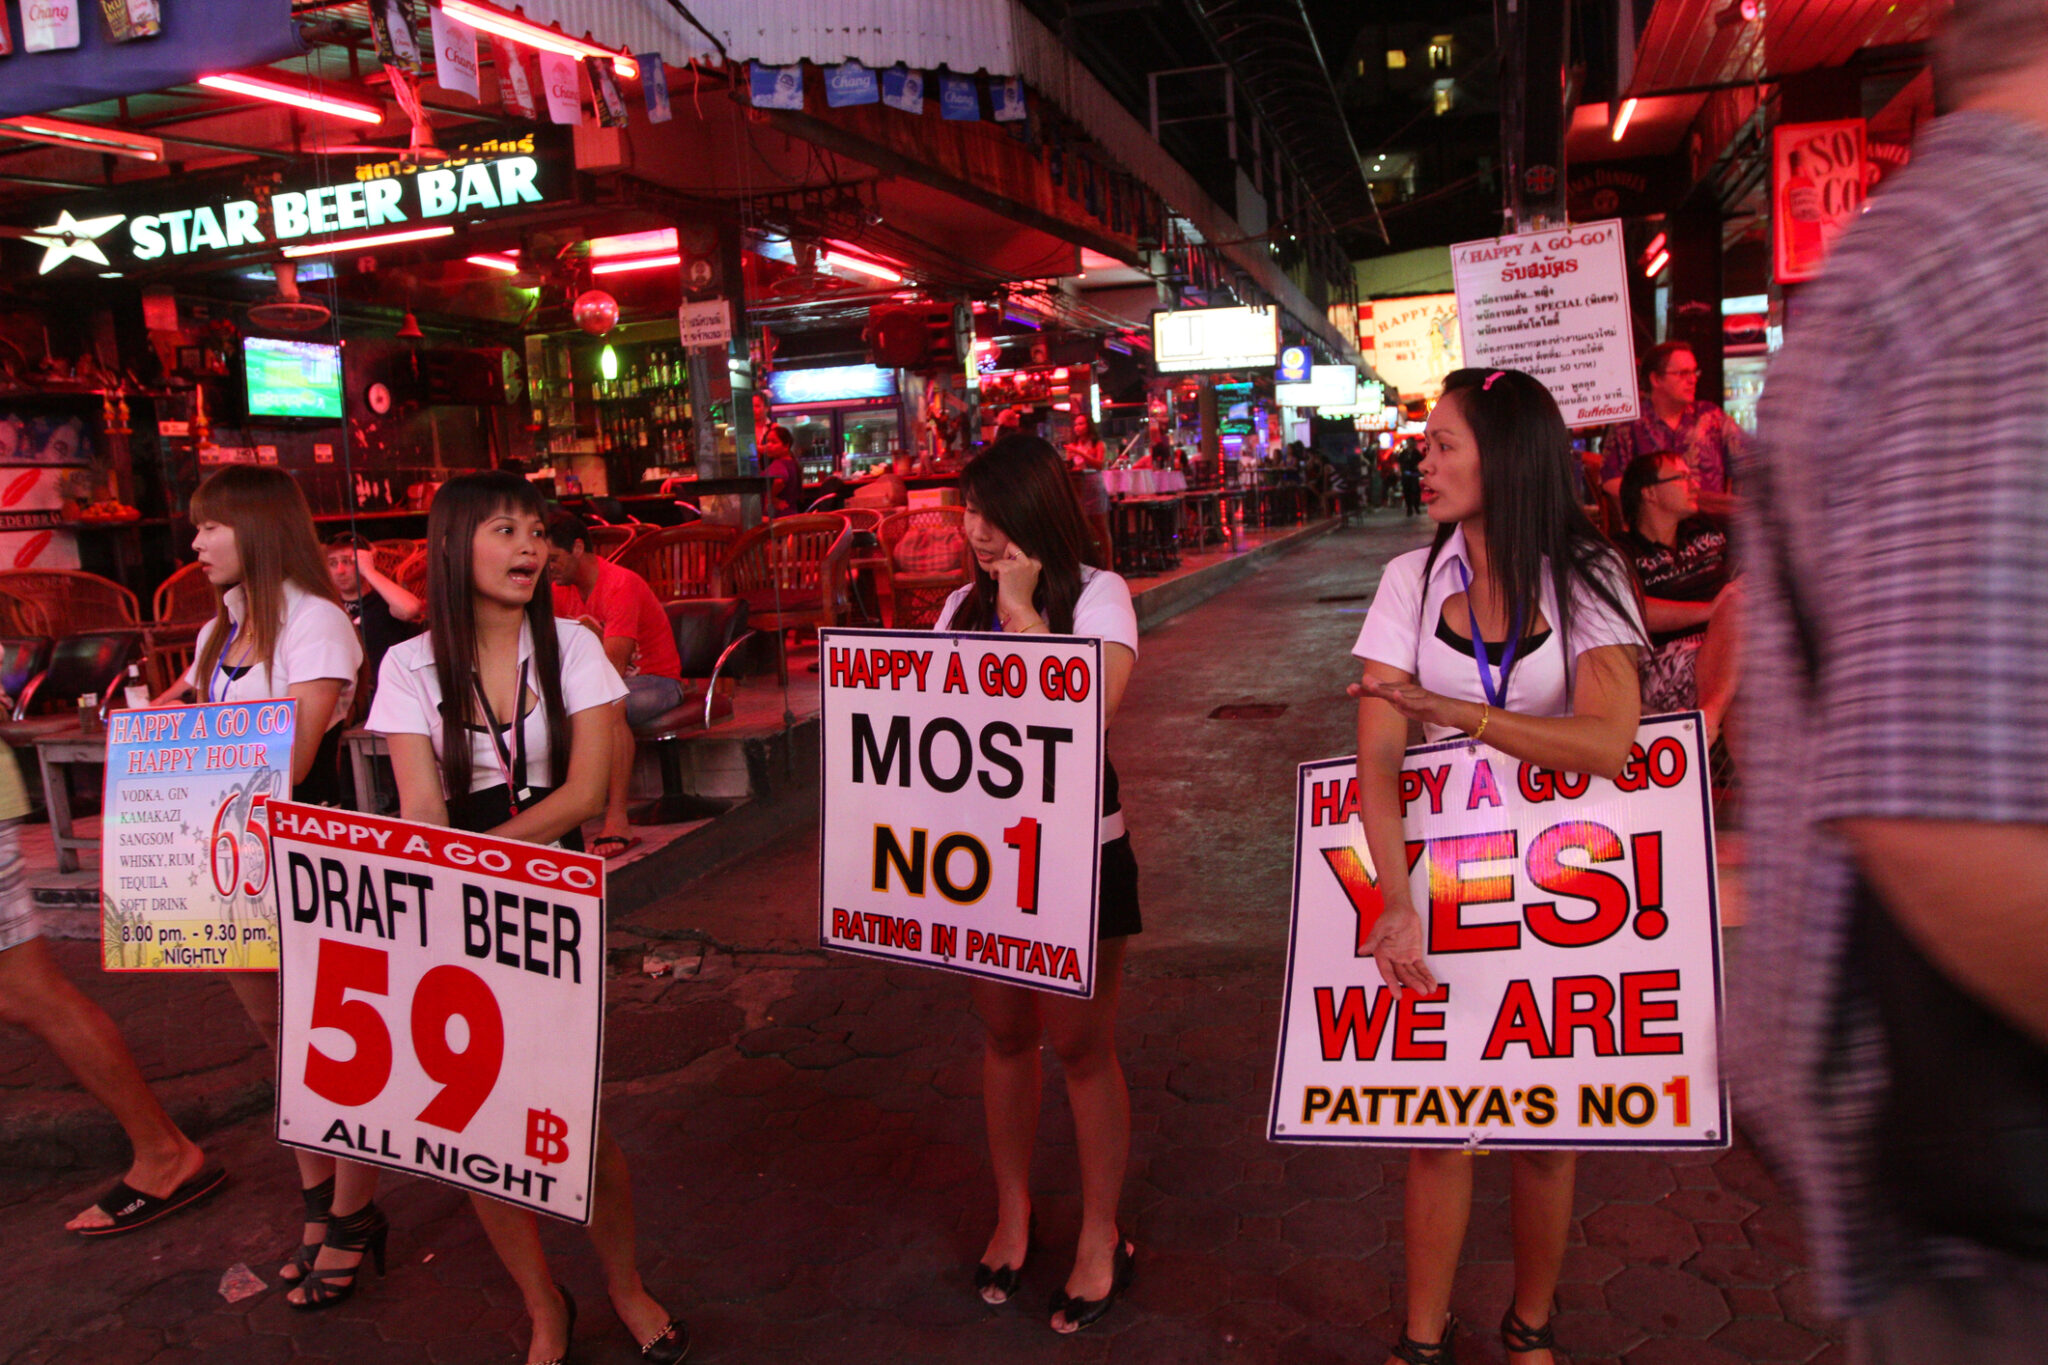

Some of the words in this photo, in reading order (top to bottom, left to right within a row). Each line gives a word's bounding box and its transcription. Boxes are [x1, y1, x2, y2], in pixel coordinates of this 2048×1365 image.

[129, 200, 265, 260] STAR
[271, 179, 408, 240] BEER
[417, 156, 544, 218] BAR
[1470, 243, 1524, 264] HAPPY
[1530, 242, 1542, 254] A
[1548, 232, 1605, 250] GO-GO
[1501, 256, 1578, 282] รับสมัคร
[1378, 306, 1429, 334] HAPPY
[1535, 299, 1582, 313] SPECIAL
[829, 647, 933, 692] HAPPY
[943, 651, 969, 695] A
[978, 652, 1027, 698] GO
[1039, 655, 1090, 703] GO
[112, 712, 185, 744] HAPPY
[190, 710, 208, 739] A
[216, 707, 249, 738] GO
[256, 704, 291, 735] GO
[128, 747, 199, 774] HAPPY
[205, 743, 268, 769] HOUR
[851, 712, 1073, 804] MOST
[168, 787, 189, 800] GIN
[1311, 763, 1452, 827] HAPY
[1467, 758, 1503, 811] A
[1613, 736, 1688, 792] GO
[120, 809, 181, 824] KAMAKAZI
[119, 832, 174, 847] SANGSOM
[211, 792, 271, 897] 65
[275, 810, 392, 850] HAPPY
[402, 834, 432, 858] A
[443, 842, 512, 873] GO
[526, 858, 597, 889] GO
[119, 876, 168, 891] TEQUILA
[1319, 819, 1669, 958] YES!
[120, 899, 147, 912] SOFT
[152, 898, 188, 911] DRINK
[288, 850, 434, 947] DRAFT
[462, 882, 582, 984] BEER
[122, 925, 152, 942] 8.00
[159, 929, 186, 945] pm.
[204, 924, 236, 941] 9.30
[242, 928, 272, 945] pm.
[832, 907, 922, 951] RATING
[931, 922, 957, 957] IN
[965, 929, 1083, 983] PATTAYA
[164, 948, 228, 965] NIGHTLY
[1313, 983, 1450, 1061] WE
[1480, 968, 1684, 1061] ARE
[303, 938, 505, 1134] 59
[1300, 1084, 1558, 1127] PATTAYA'S
[321, 1118, 401, 1159] ALL
[415, 1136, 557, 1203] NIGHT
